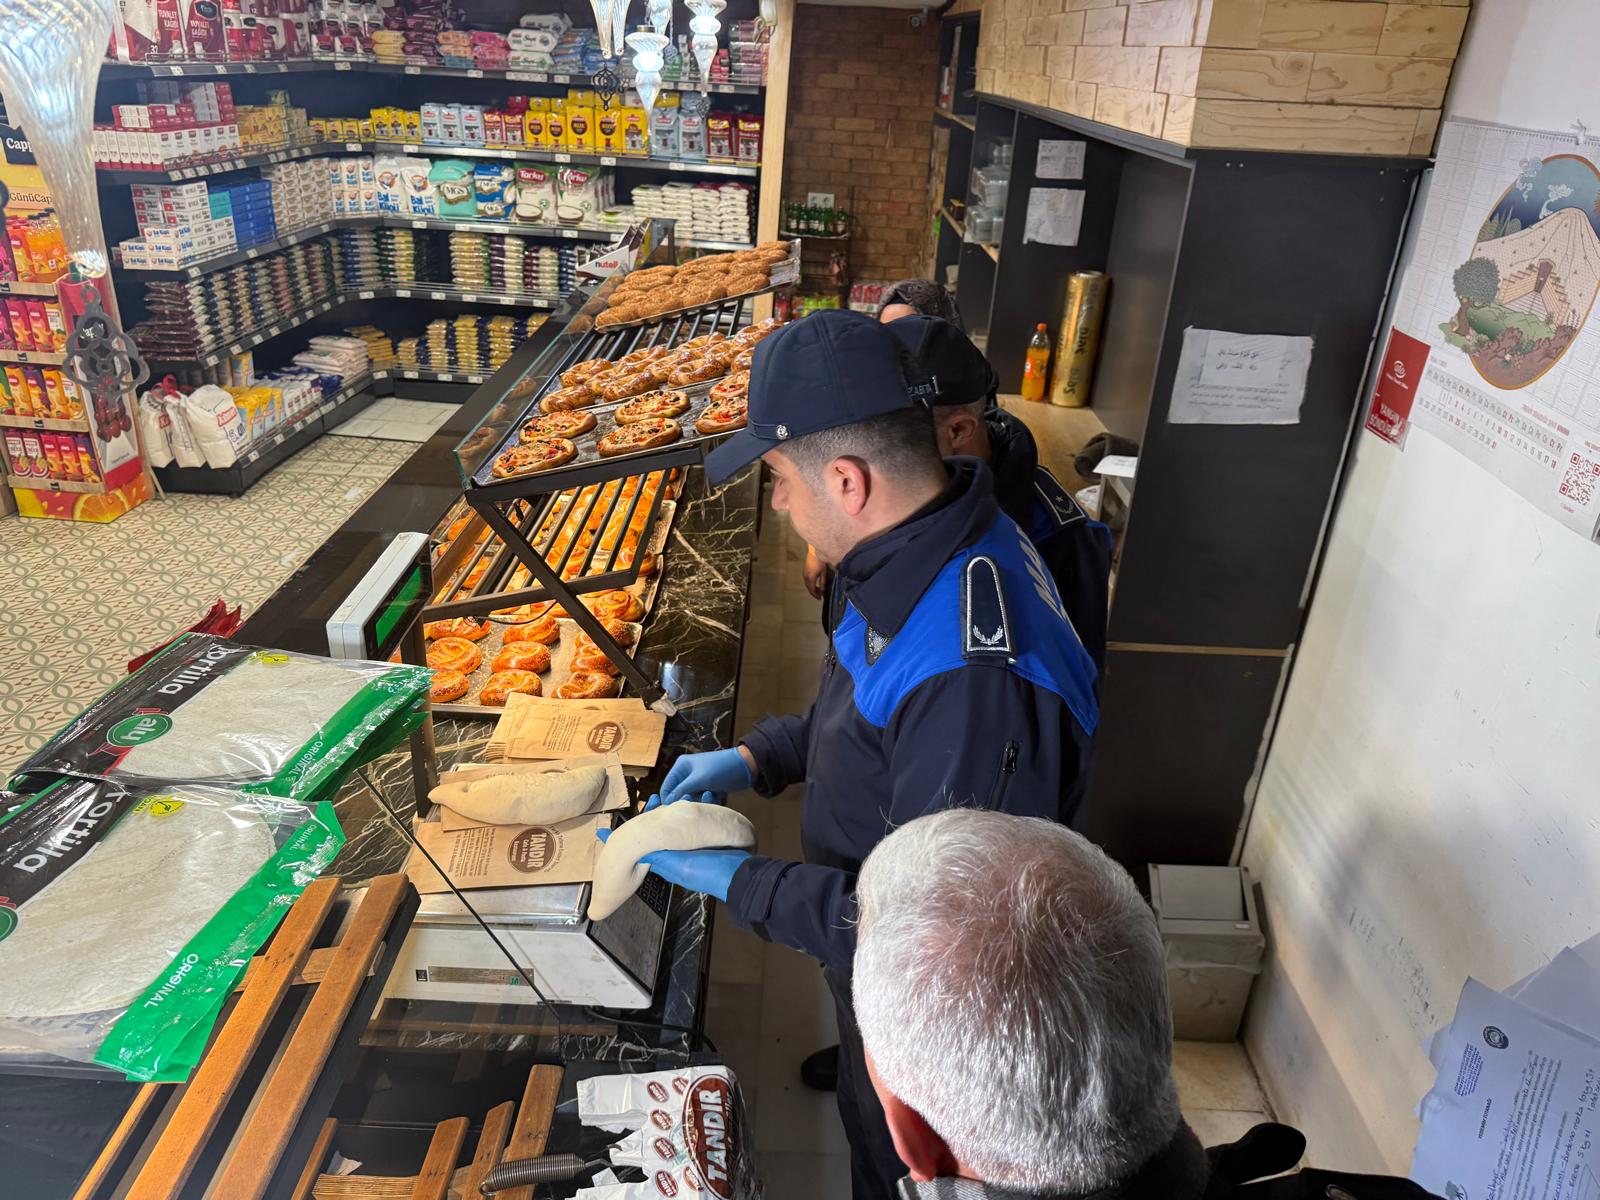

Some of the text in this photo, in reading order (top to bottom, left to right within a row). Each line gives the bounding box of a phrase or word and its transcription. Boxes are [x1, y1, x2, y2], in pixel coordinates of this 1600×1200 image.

[13, 788, 127, 874] Tortilla
[526, 831, 546, 869] TANDIR
[144, 953, 199, 1008] ORIGINAL
[699, 1088, 728, 1182] TANDIR
